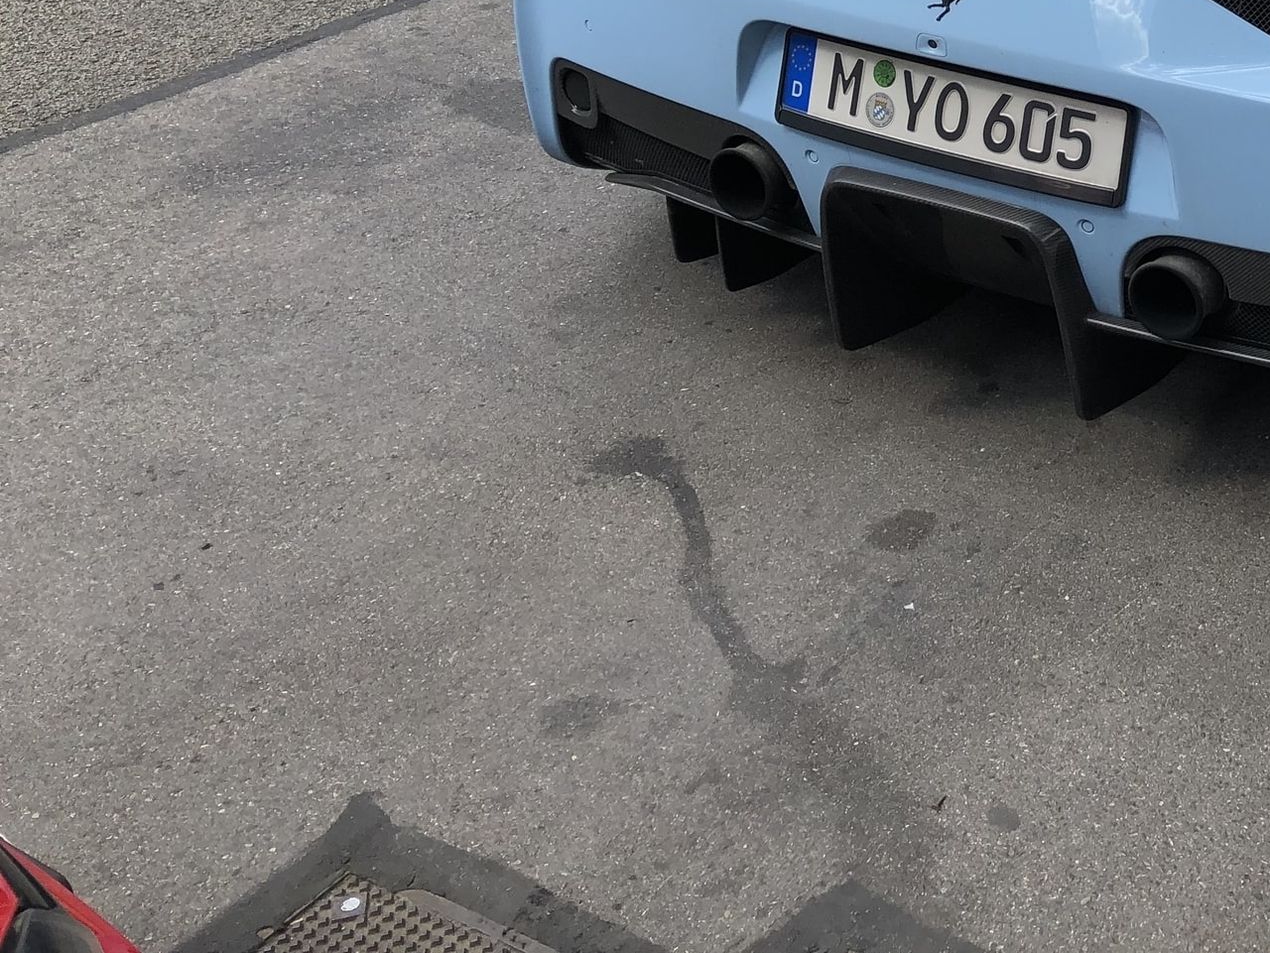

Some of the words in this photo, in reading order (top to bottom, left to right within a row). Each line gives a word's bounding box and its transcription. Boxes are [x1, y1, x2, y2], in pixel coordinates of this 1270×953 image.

[791, 80, 803, 98] D
[828, 52, 865, 117] M
[903, 69, 970, 142] YO
[983, 93, 1097, 170] 605
